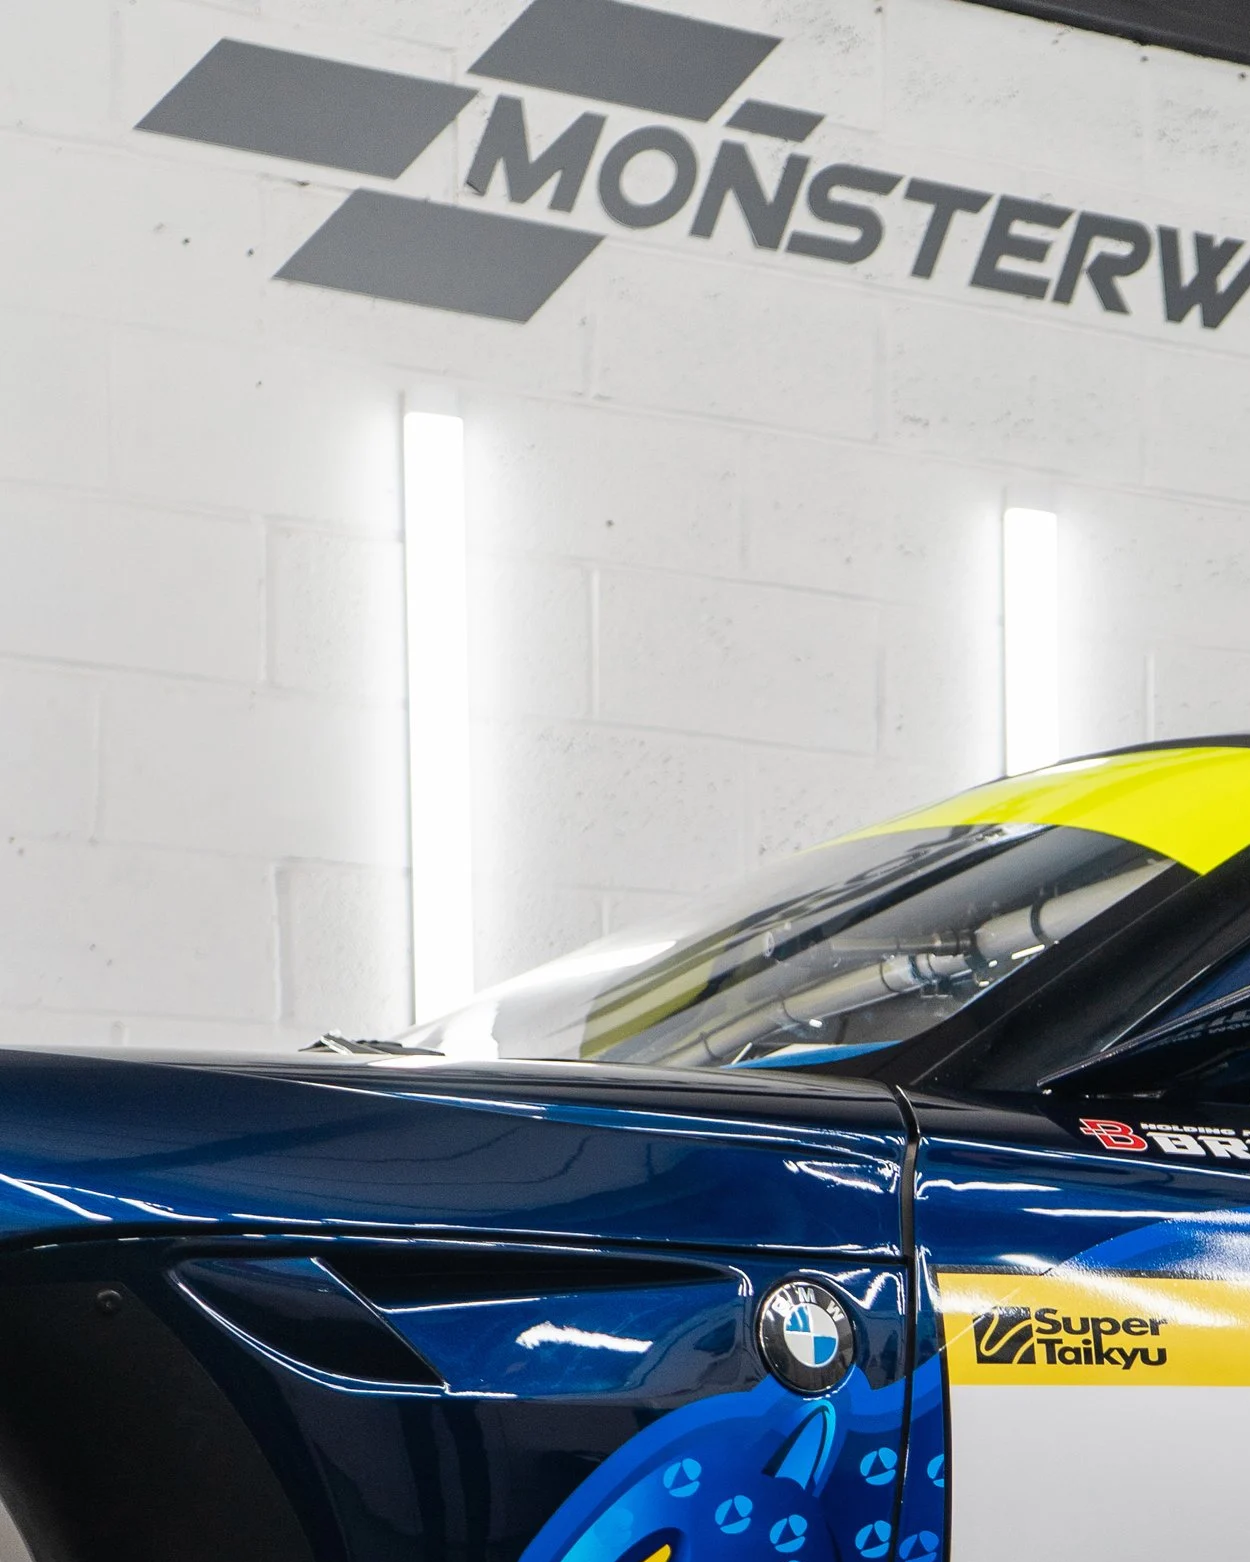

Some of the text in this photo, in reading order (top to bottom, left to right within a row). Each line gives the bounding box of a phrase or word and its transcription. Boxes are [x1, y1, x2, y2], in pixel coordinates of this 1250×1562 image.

[1140, 1122, 1236, 1136] HOLDING
[1035, 1307, 1169, 1342] Super
[1036, 1337, 1168, 1371] Taikyu
